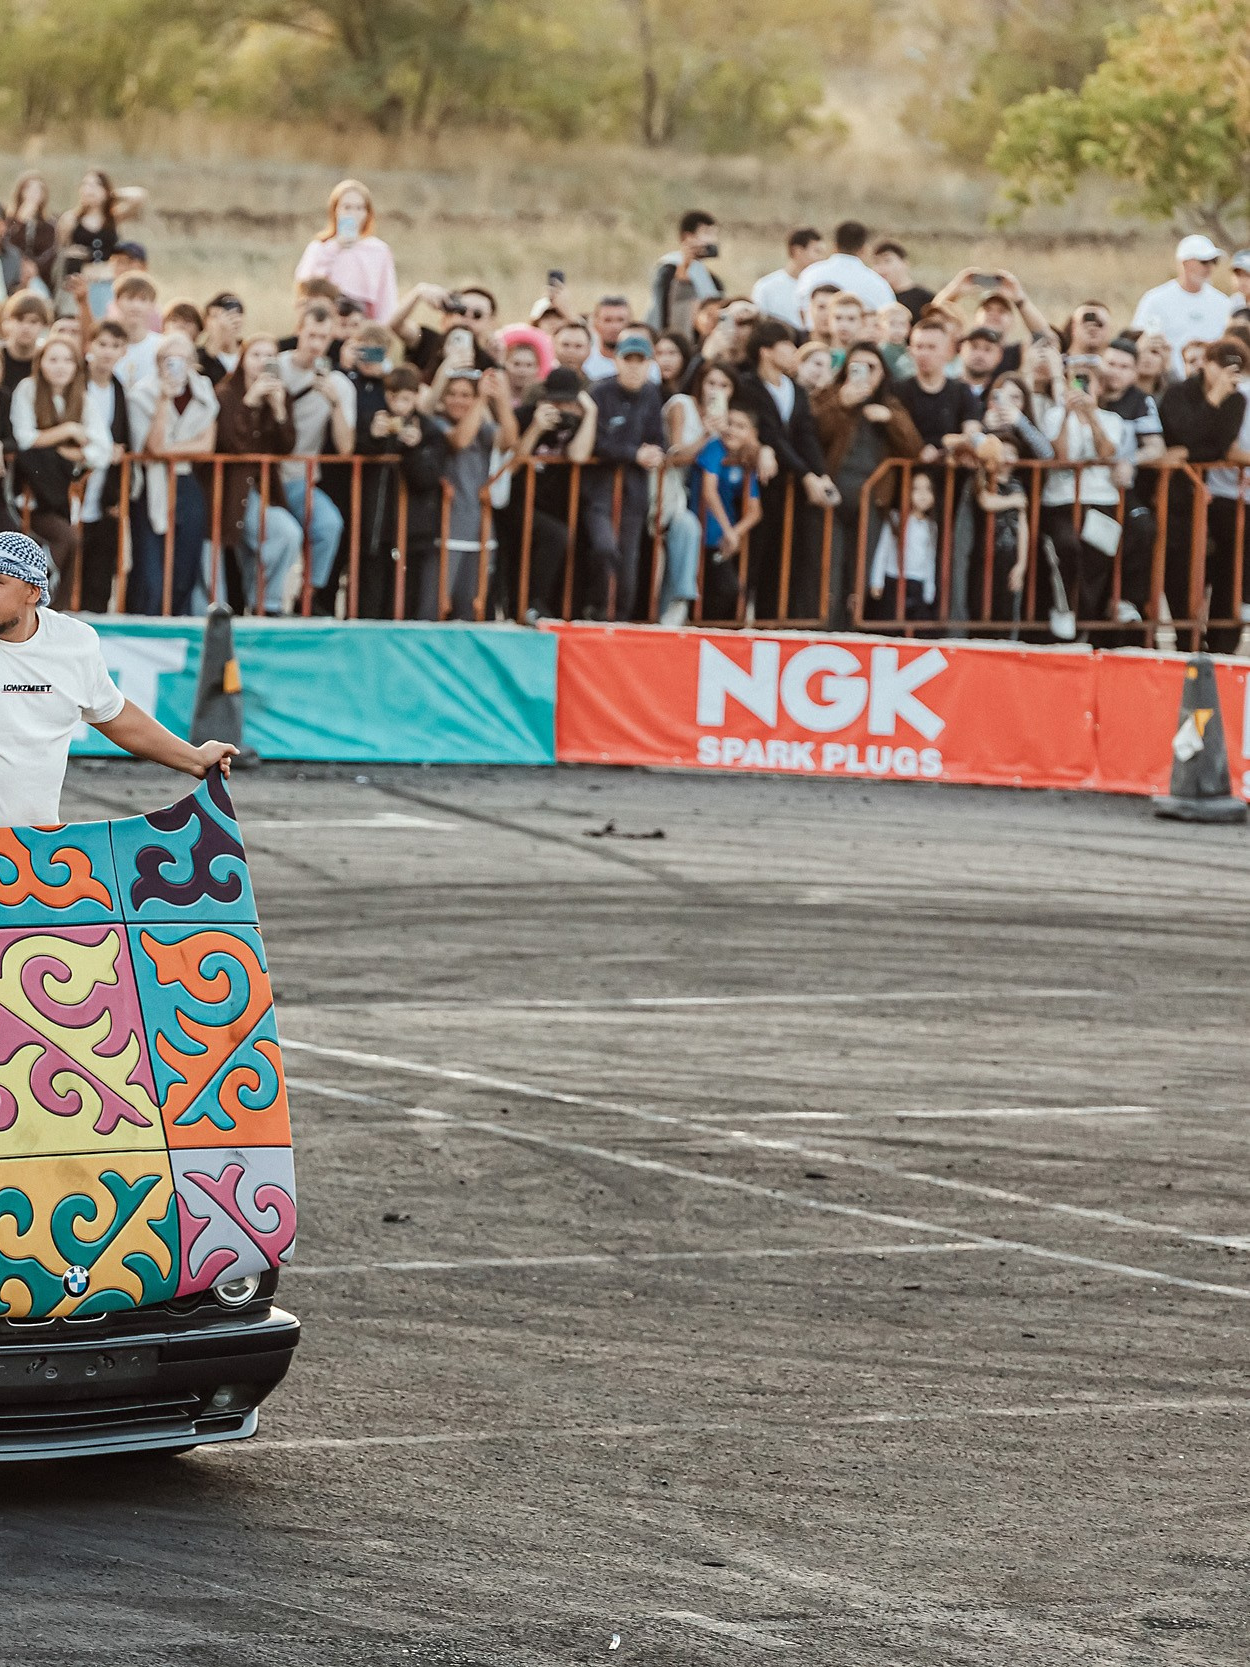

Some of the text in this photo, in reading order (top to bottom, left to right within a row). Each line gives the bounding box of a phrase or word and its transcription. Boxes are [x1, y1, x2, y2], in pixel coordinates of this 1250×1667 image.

[696, 639, 949, 742] NGK
[697, 735, 944, 777] SPARK PLUGS
